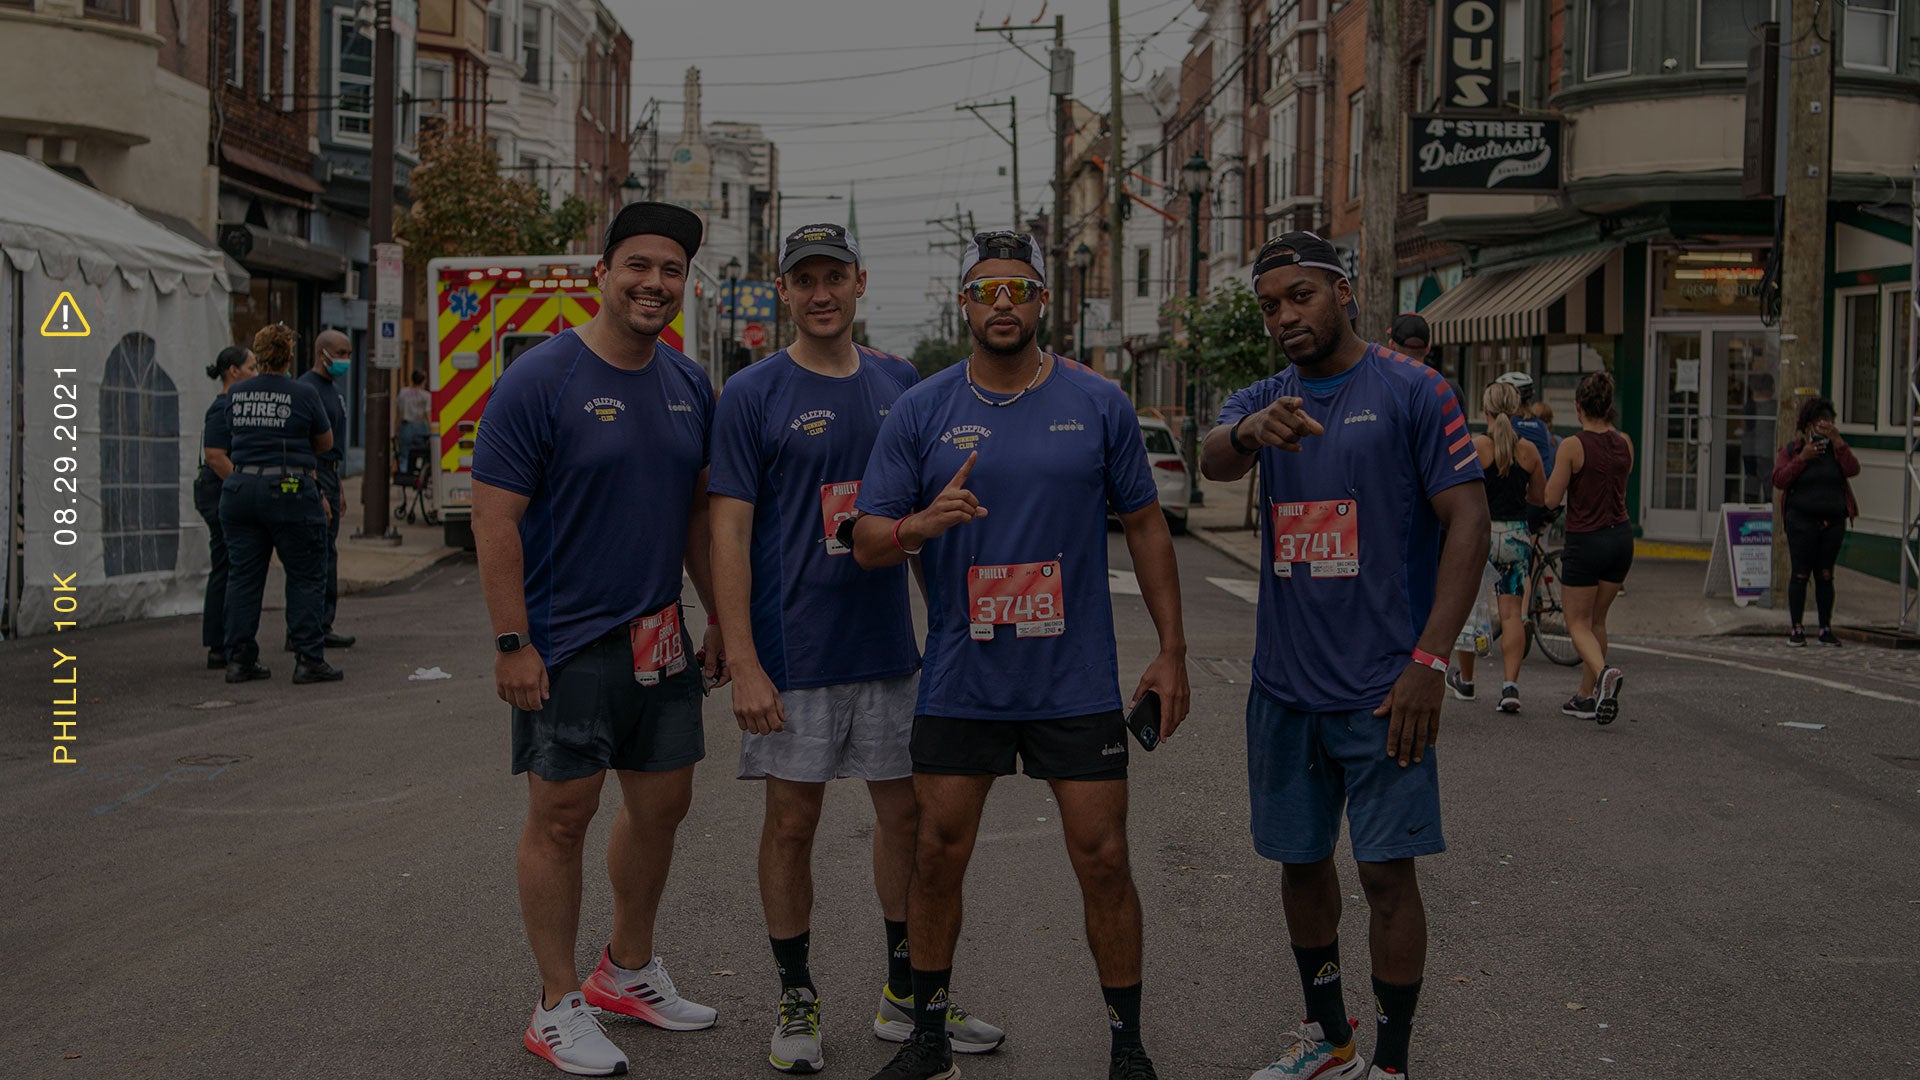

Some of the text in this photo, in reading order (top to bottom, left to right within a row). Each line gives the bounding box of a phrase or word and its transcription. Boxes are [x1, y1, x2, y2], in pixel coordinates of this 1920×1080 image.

[1456, 120, 1545, 138] STREET
[1419, 137, 1547, 173] Delicatessen
[231, 391, 291, 405] PHILADELPHIA
[593, 398, 626, 411] SLEEPING
[242, 402, 277, 417] FIRE
[232, 416, 287, 428] DEPARTMENT
[790, 409, 836, 431] NO SLEEPING
[940, 425, 992, 443] NO SLEEPING
[832, 483, 858, 496] PHILLY
[1278, 504, 1304, 516] PHILLY
[1279, 532, 1346, 560] 3741
[978, 568, 1007, 580] PHILLY
[977, 593, 1055, 622] 3743
[642, 615, 663, 630] PHILLY
